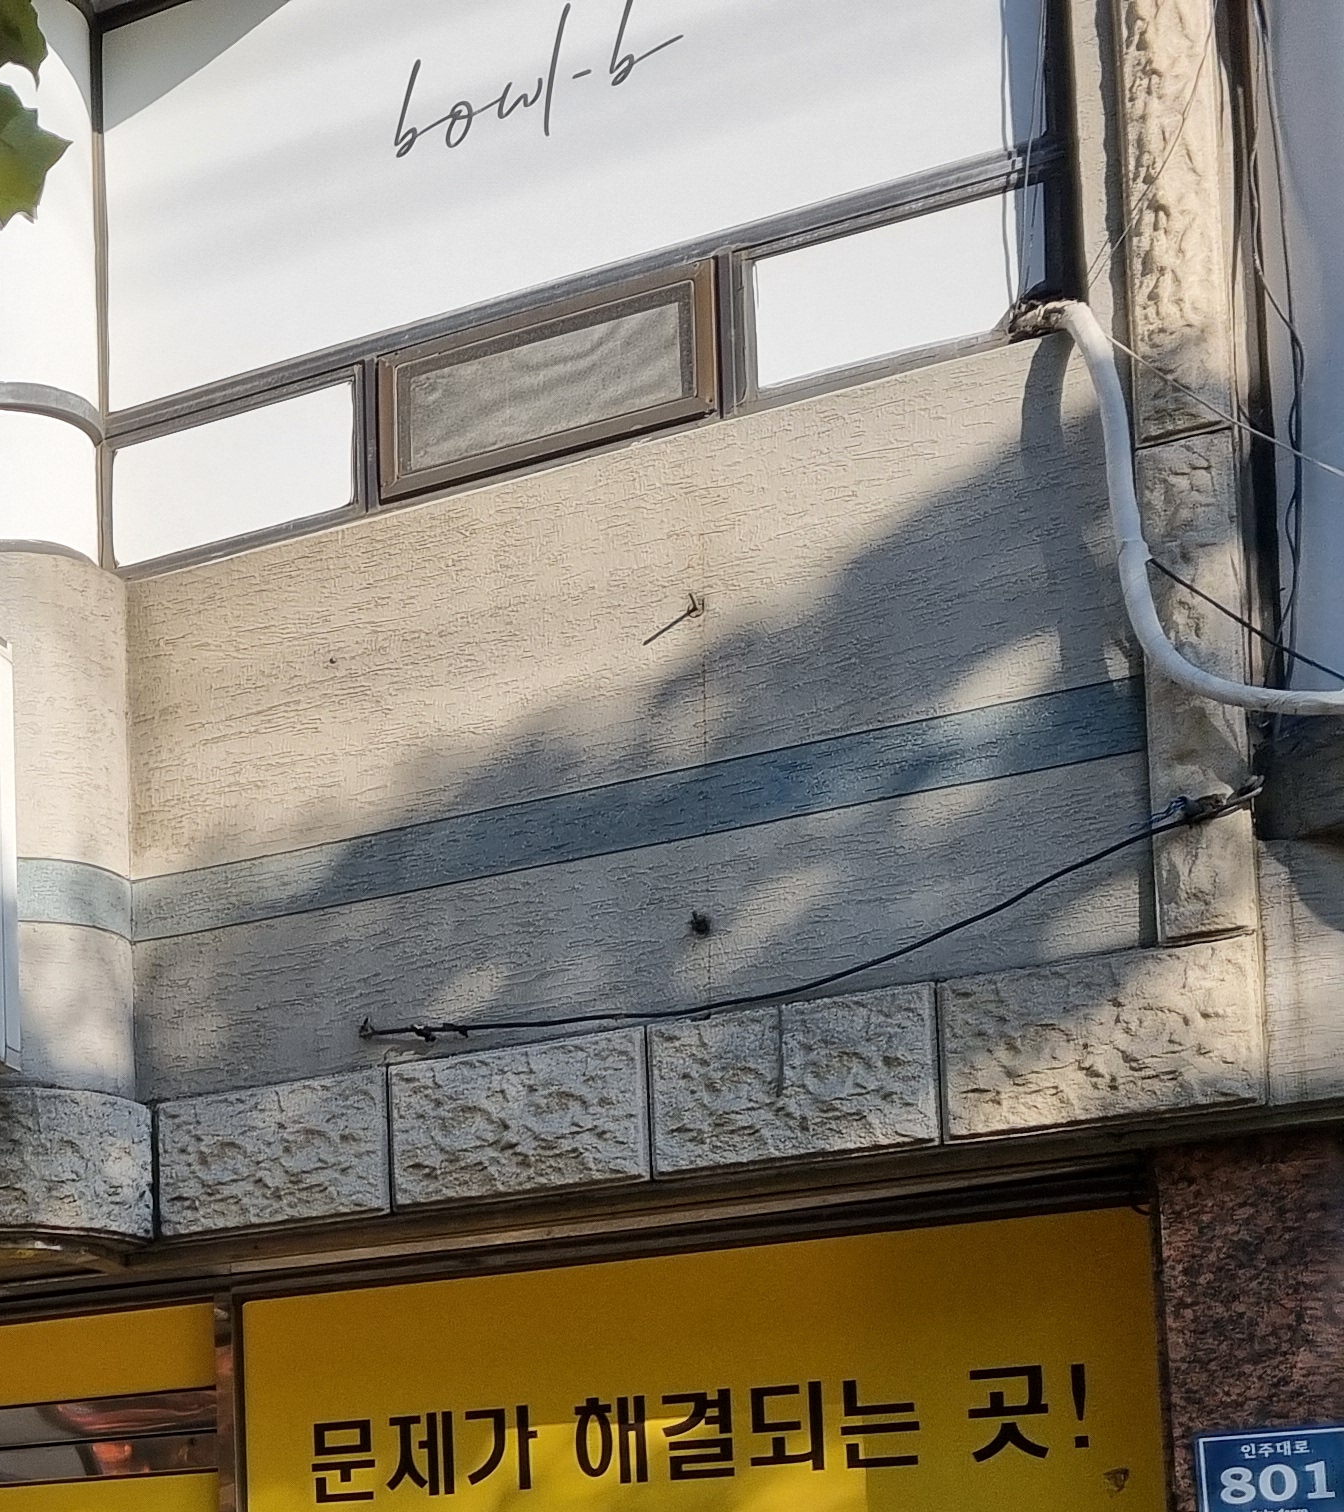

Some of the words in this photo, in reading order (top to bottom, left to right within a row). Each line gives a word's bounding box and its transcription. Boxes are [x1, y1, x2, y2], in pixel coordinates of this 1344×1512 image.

[310, 1403, 538, 1504] 문제가
[573, 1379, 921, 1485] 해결되는
[968, 1363, 1090, 1463] 곳!
[1240, 1439, 1310, 1459] 인주대로
[1220, 1460, 1336, 1504] 801
